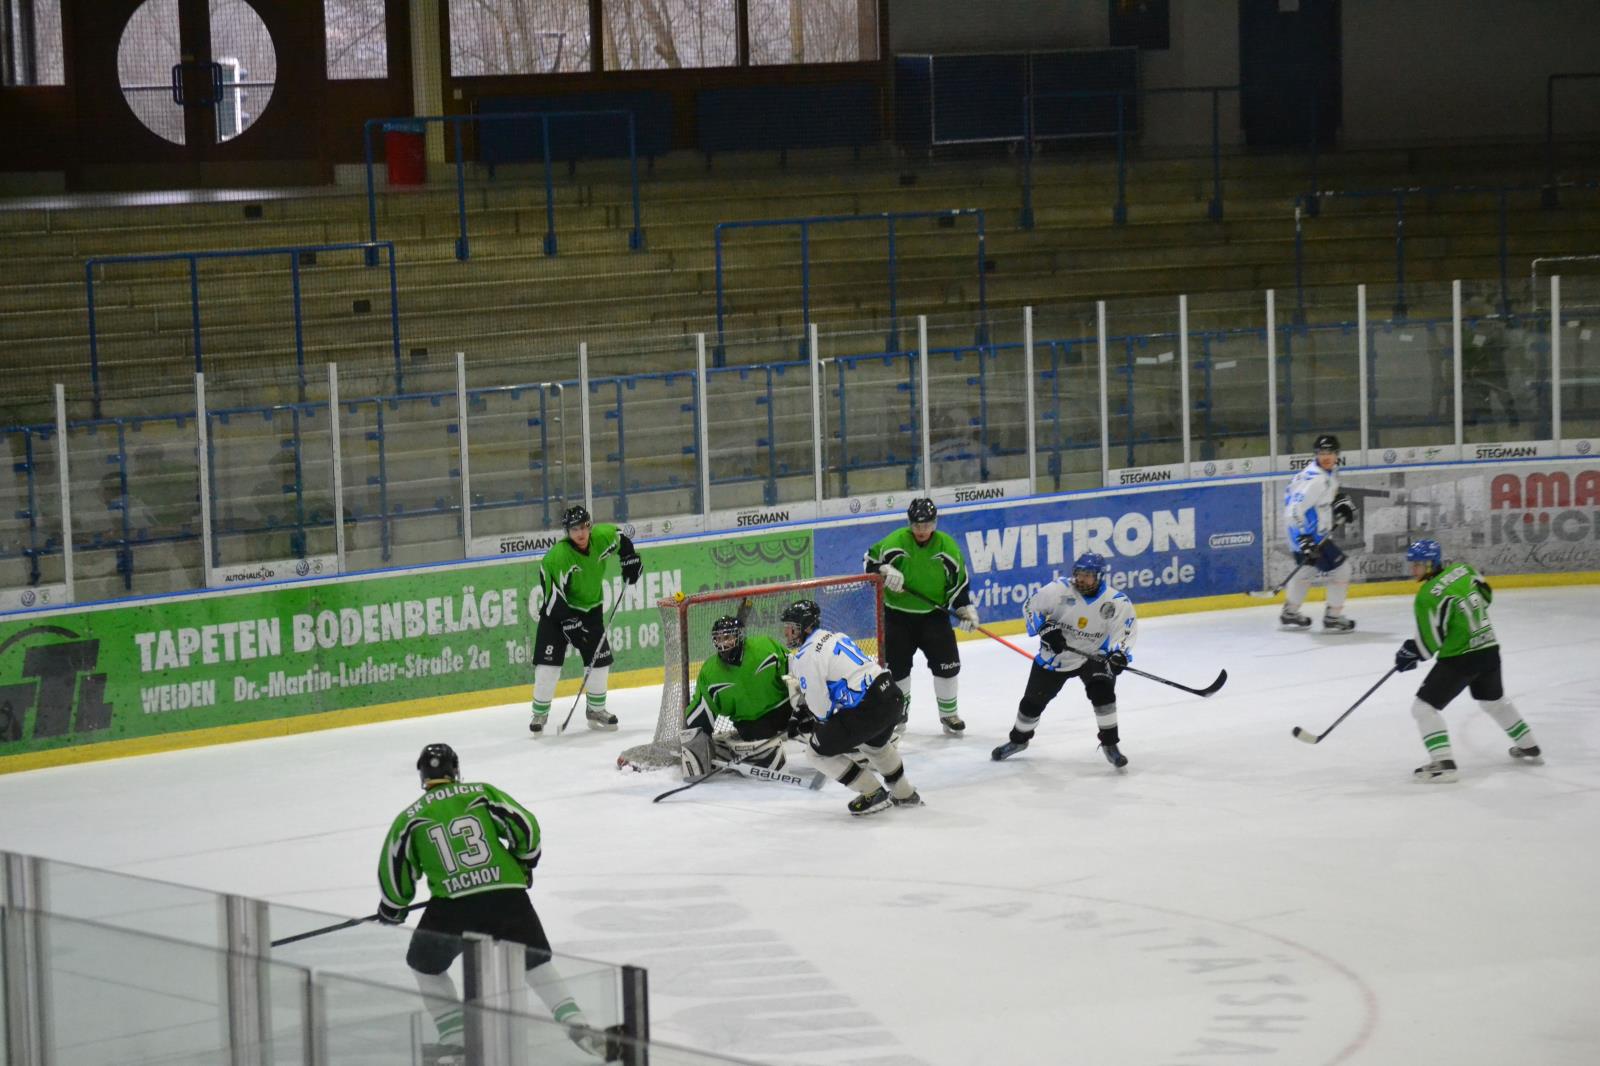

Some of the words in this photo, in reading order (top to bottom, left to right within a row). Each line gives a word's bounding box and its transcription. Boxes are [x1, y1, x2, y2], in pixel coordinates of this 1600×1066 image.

[1476, 446, 1537, 459] STEGMANN
[1120, 470, 1171, 485] STEGMANN
[955, 487, 1004, 503] STEGMANN
[737, 511, 789, 527] STEGMANN
[500, 537, 556, 554] STEGMANN
[965, 507, 1196, 574] WITRON
[134, 617, 281, 673] TAPETEN
[292, 586, 518, 653] BODENBELÄGE
[140, 680, 216, 714] WEIDEN
[234, 645, 464, 702] Dr.-Martin-Luther-Straße
[468, 644, 490, 670] 2a
[638, 622, 660, 648] 08
[406, 802, 424, 818] SK
[425, 784, 485, 804] POLICIE
[427, 815, 492, 875] 13
[442, 866, 501, 893] TACHOV
